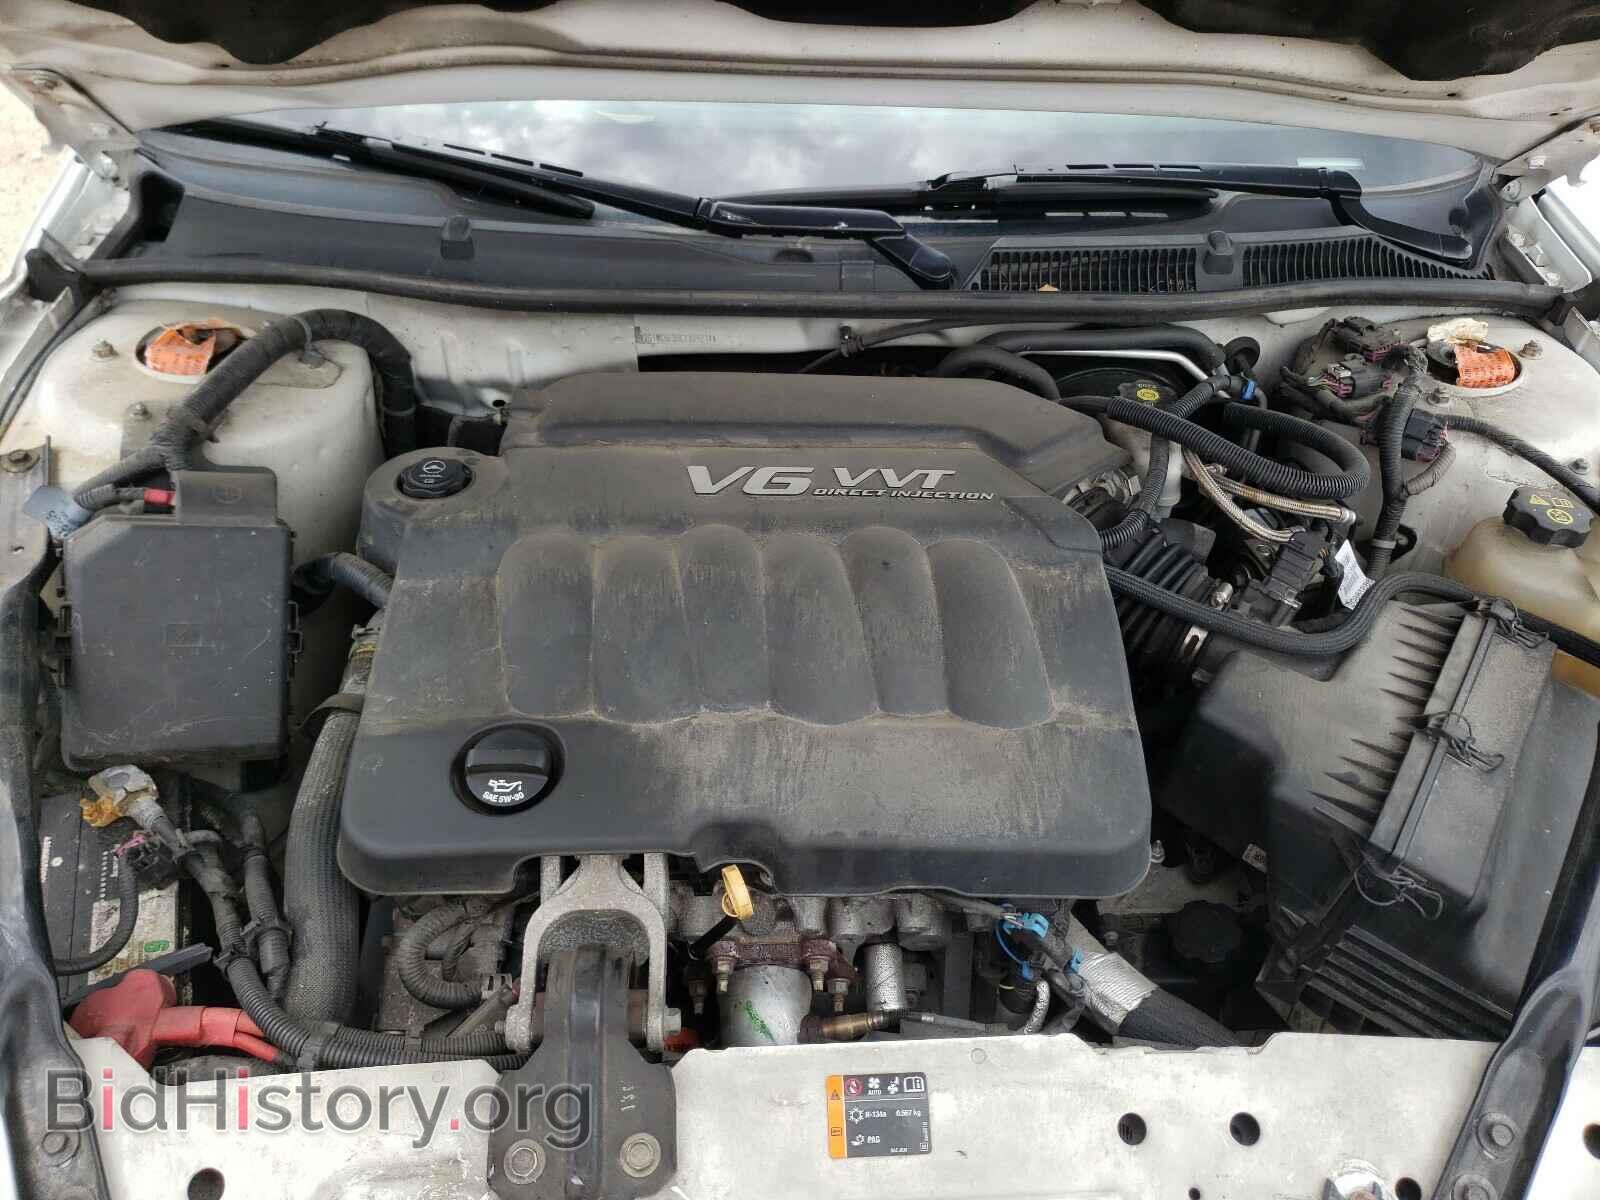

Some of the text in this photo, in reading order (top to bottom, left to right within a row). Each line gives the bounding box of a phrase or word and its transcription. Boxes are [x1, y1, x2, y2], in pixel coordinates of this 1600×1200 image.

[687, 465, 956, 495] V6 VVT
[813, 487, 994, 501] DIRECT INJECTION
[482, 791, 498, 802] SAE
